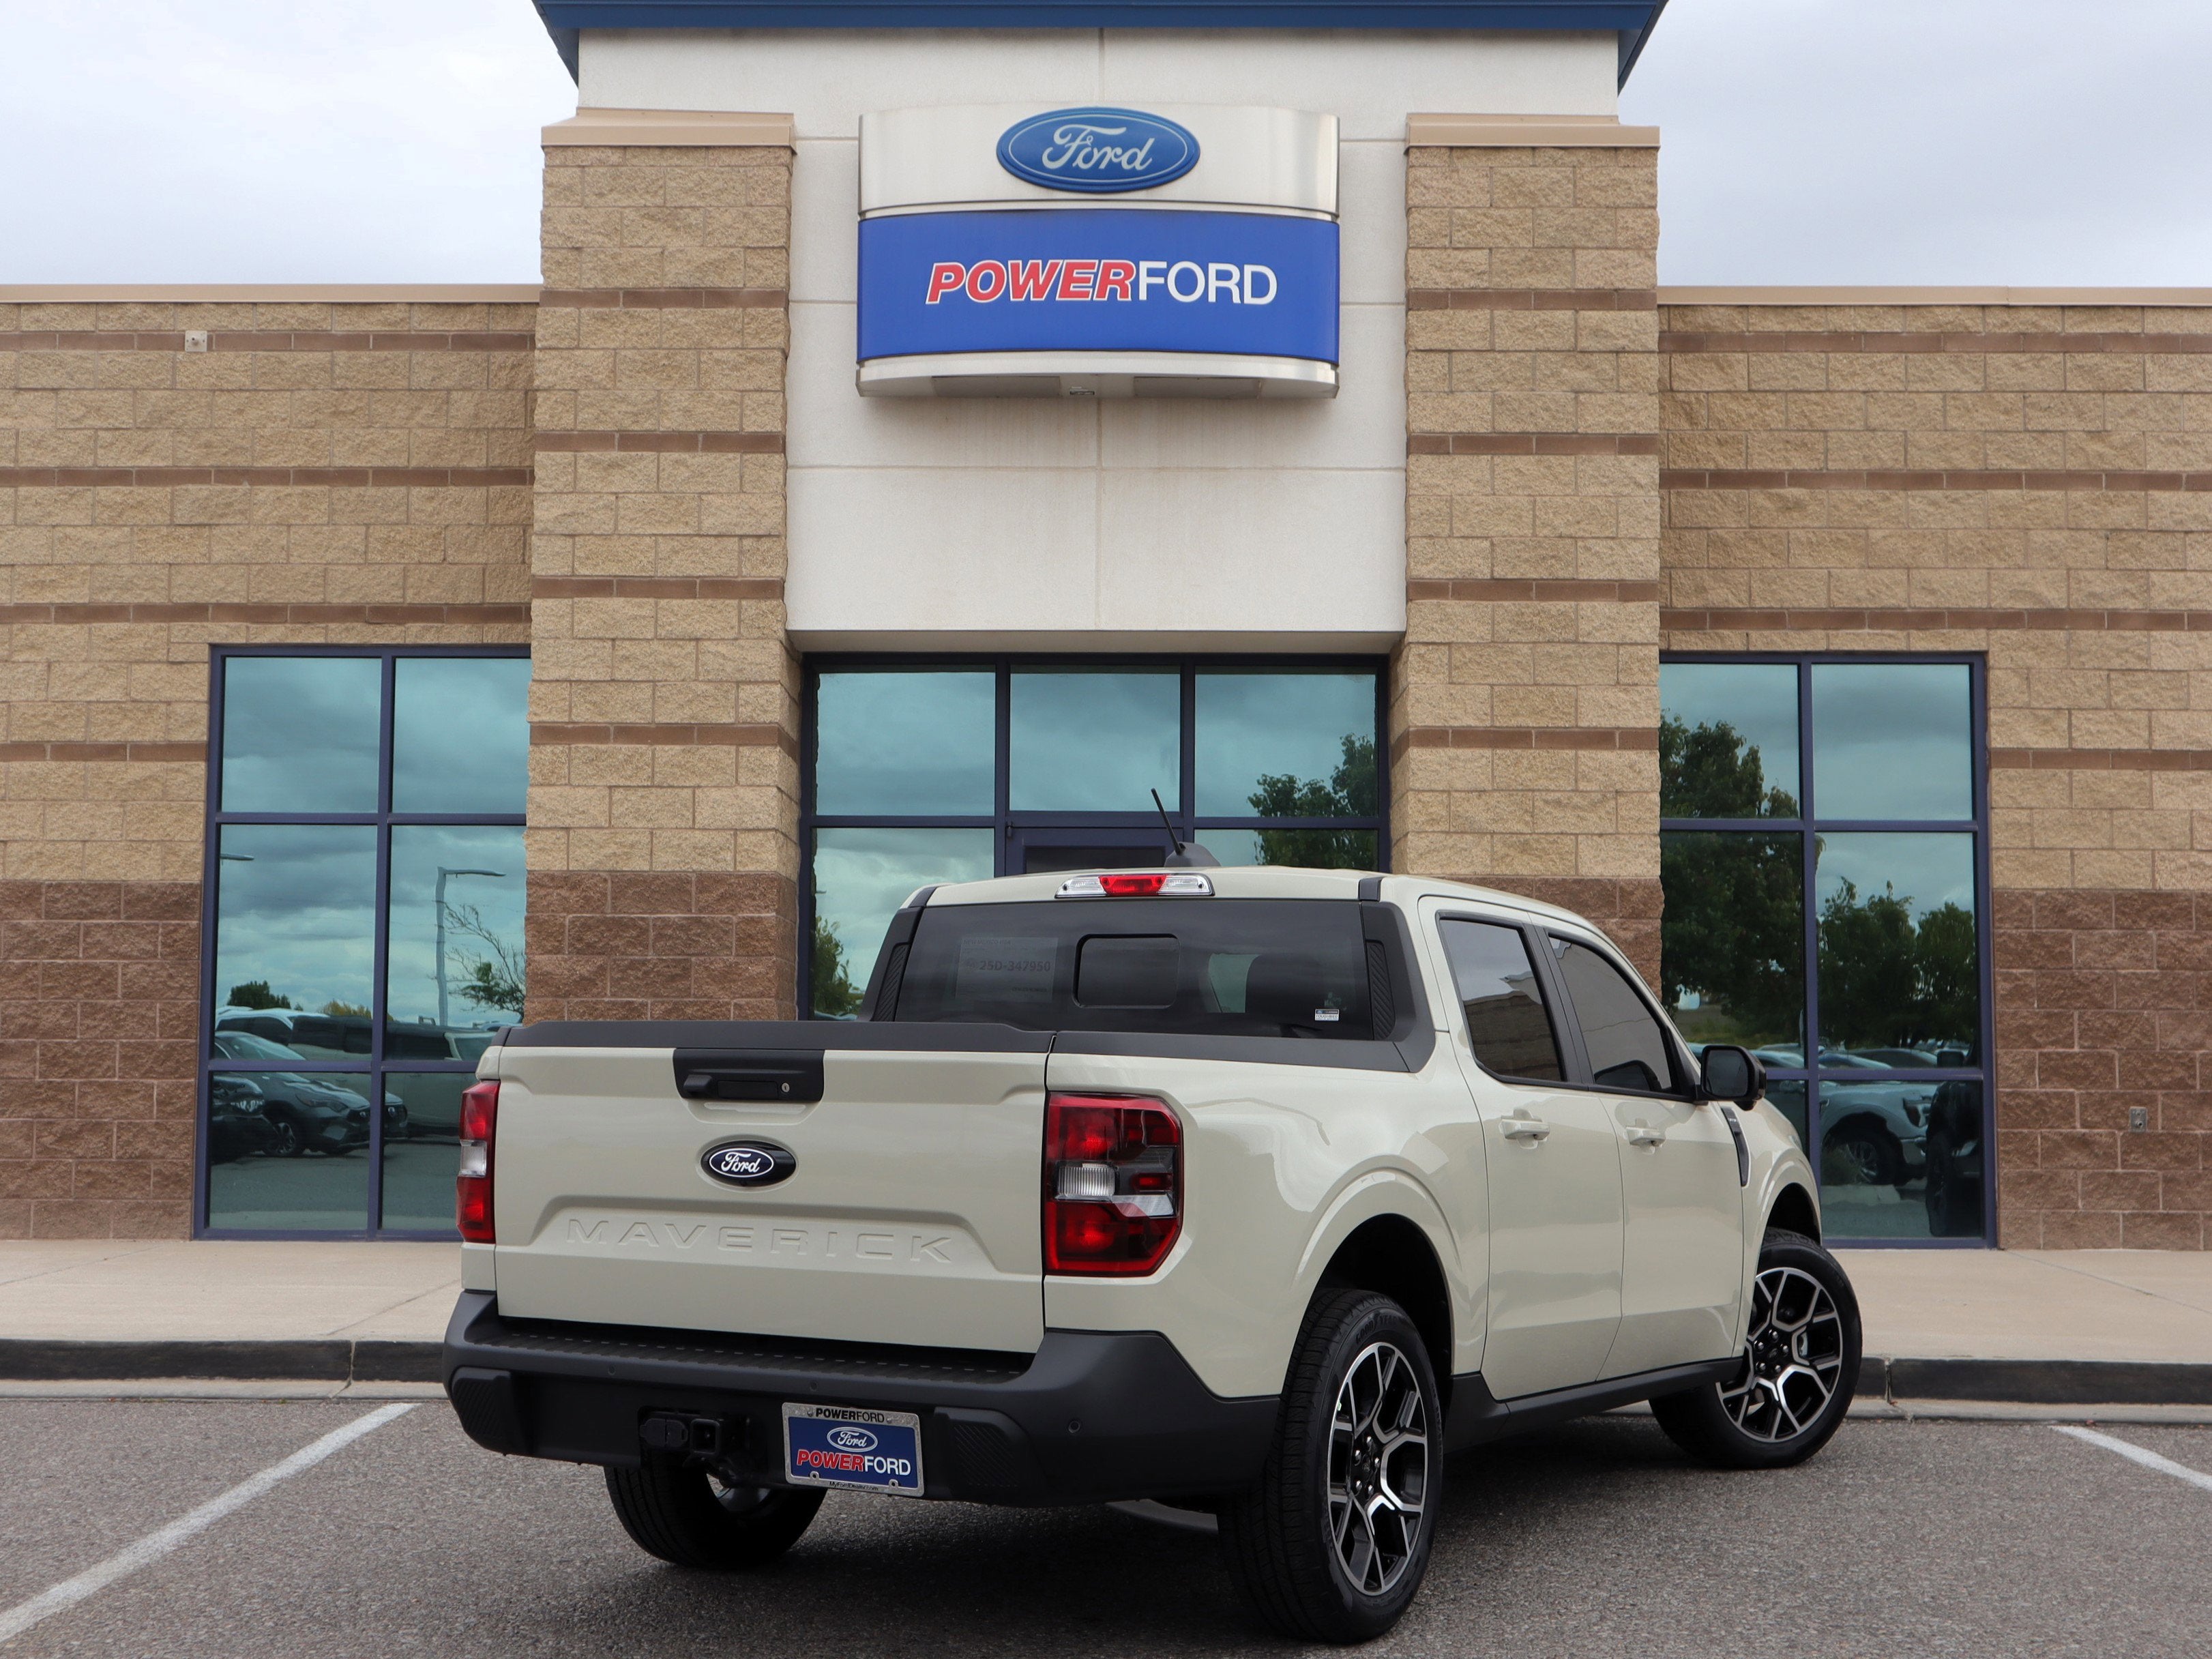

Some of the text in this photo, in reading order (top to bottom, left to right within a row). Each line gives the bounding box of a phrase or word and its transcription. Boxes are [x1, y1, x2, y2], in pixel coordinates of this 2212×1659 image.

[1042, 123, 1155, 171] Ford
[926, 259, 1278, 306] POWERFORD
[720, 1151, 761, 1173] Ford
[566, 1218, 952, 1264] MAVERICK
[815, 1407, 885, 1423] POWERFORD
[837, 1430, 868, 1448] Ford
[797, 1449, 911, 1476] POWERFORD
